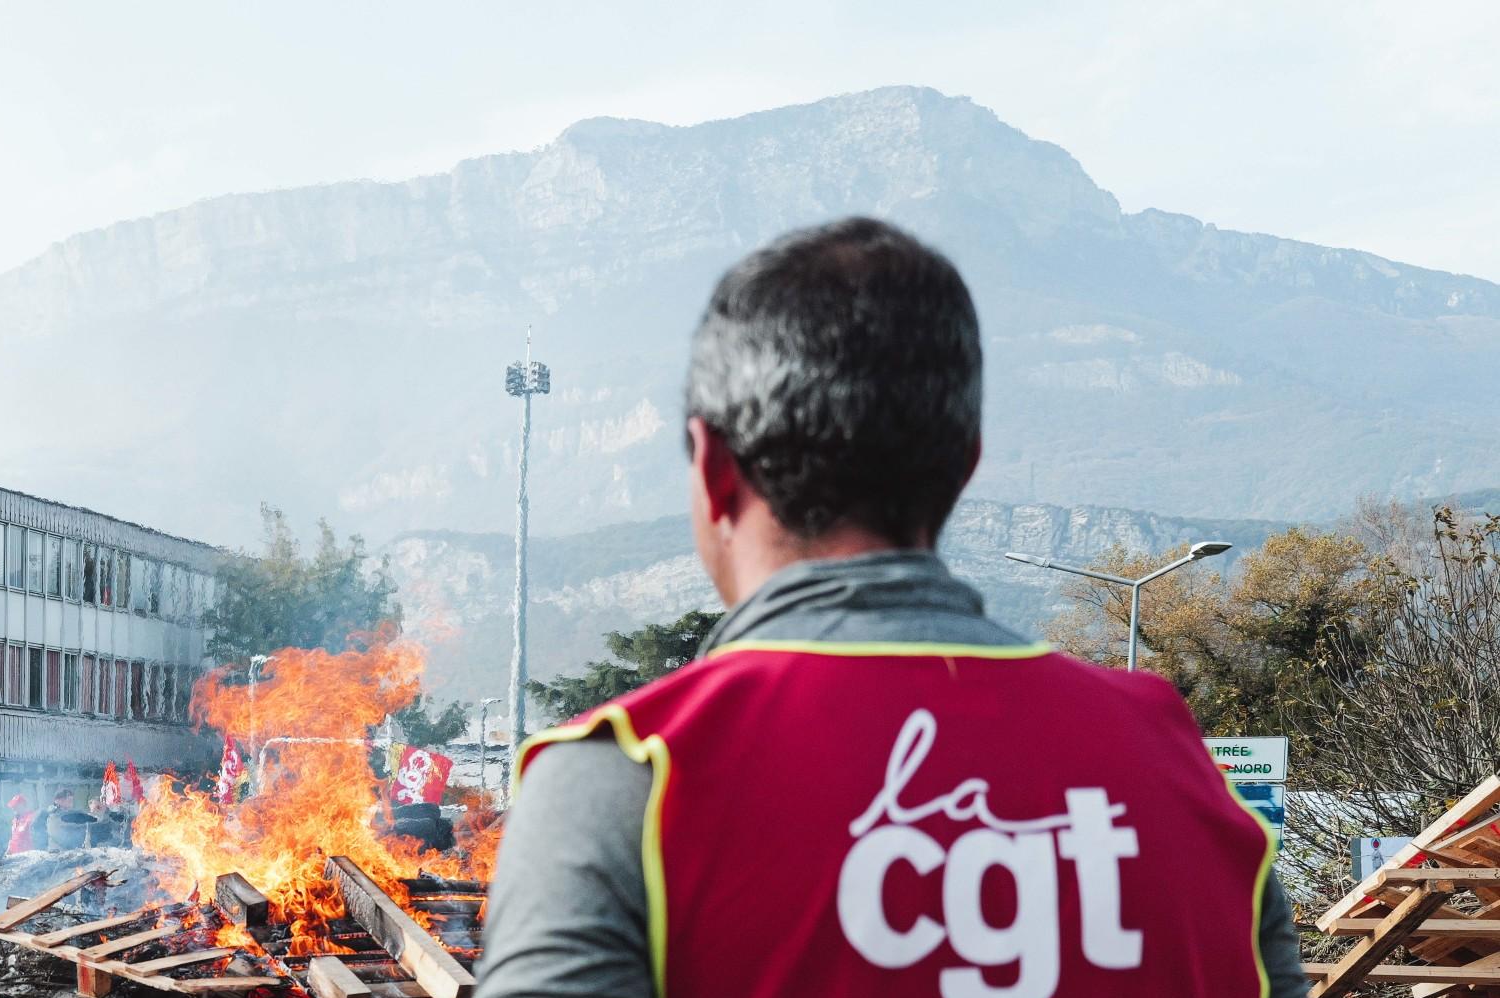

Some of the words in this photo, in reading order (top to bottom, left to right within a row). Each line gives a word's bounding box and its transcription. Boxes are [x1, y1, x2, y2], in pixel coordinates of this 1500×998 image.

[1211, 744, 1249, 757] TRÉE
[849, 708, 1100, 837] la
[1234, 764, 1272, 774] NORD
